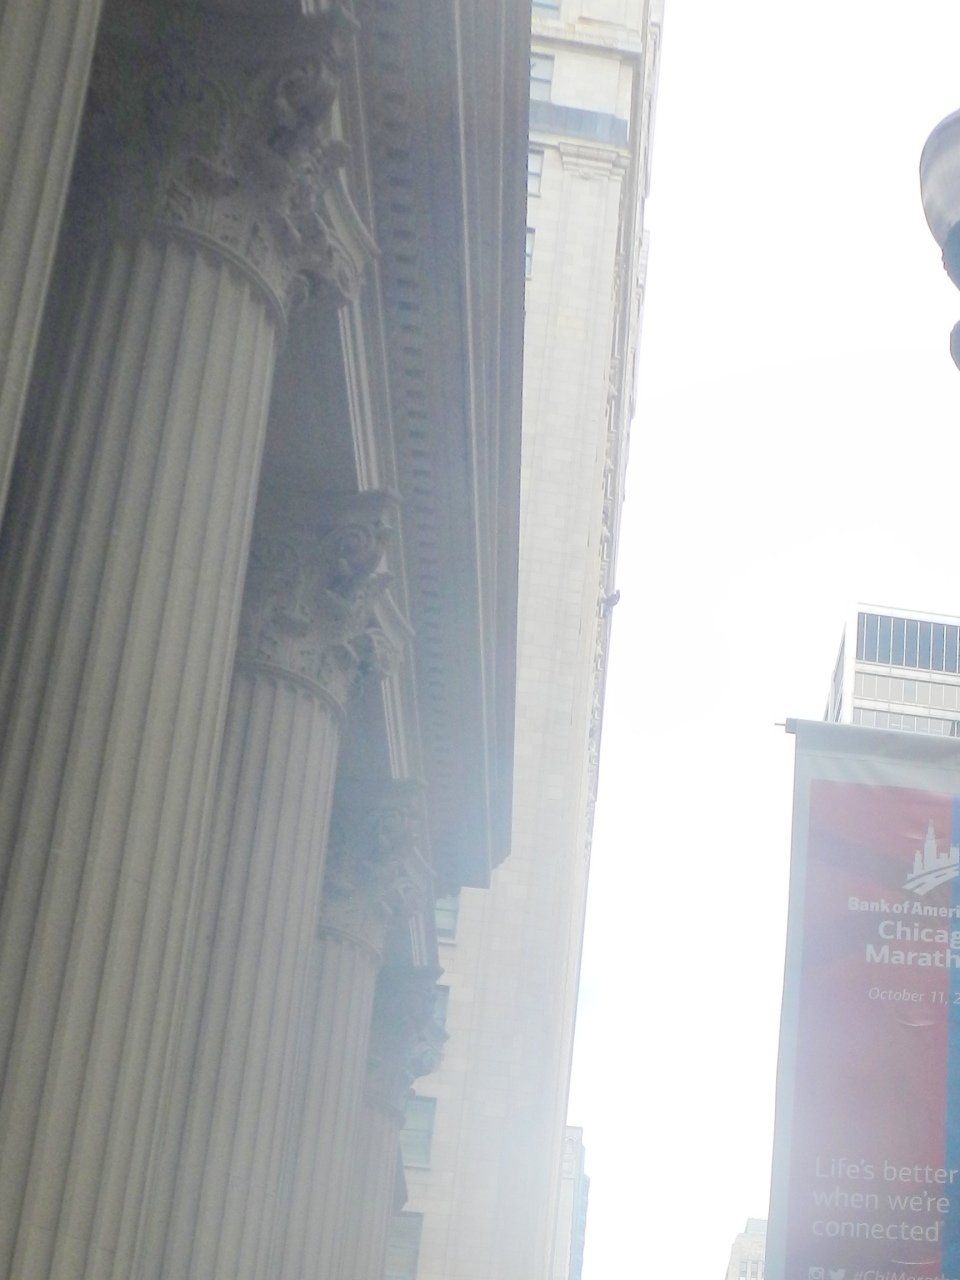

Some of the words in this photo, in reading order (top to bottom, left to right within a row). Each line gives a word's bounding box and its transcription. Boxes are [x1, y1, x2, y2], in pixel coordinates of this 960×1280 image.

[847, 896, 892, 914] Bank
[892, 900, 909, 914] of
[868, 986, 925, 1003] October
[930, 990, 948, 1006] 11,
[815, 1156, 875, 1180] Life's
[883, 1161, 959, 1185] better
[812, 1187, 879, 1211] when
[888, 1191, 951, 1214] we're
[812, 1219, 940, 1243] connected
